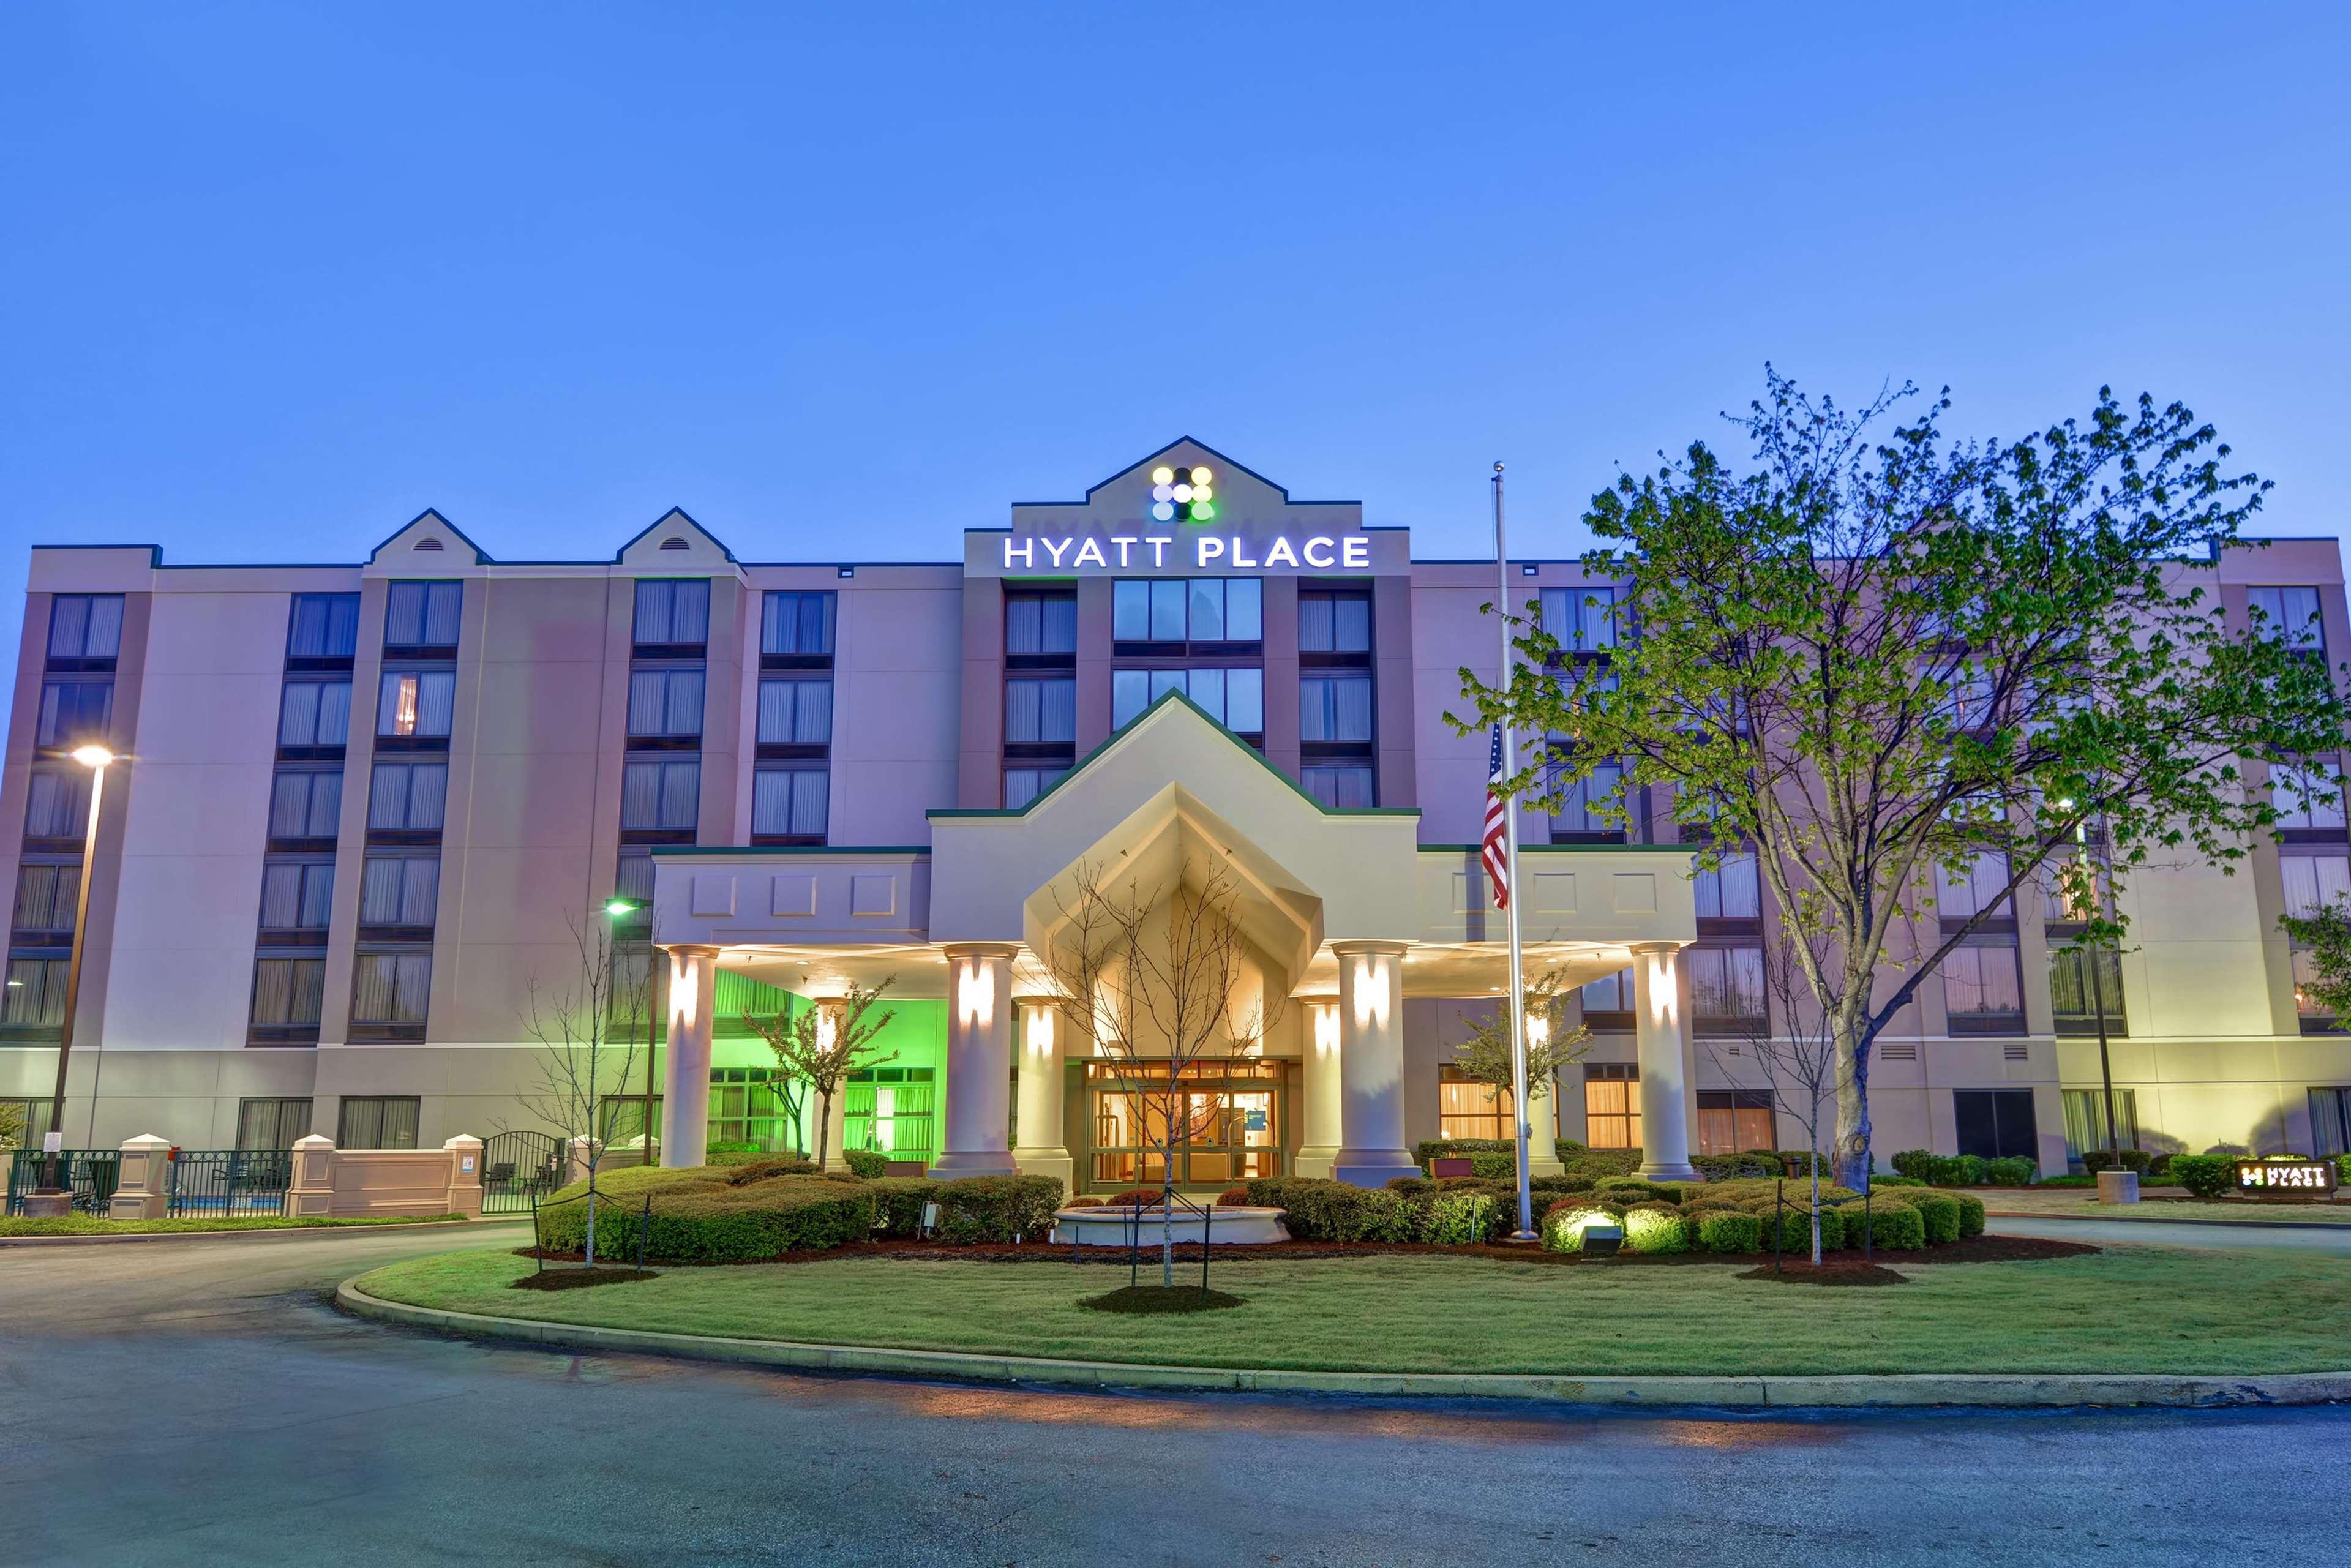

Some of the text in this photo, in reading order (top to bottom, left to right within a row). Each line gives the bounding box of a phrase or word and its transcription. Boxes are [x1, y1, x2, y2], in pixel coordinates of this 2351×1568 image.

[1004, 536, 1370, 568] HYATT PLACE
[2267, 1167, 2324, 1179] HYATT
[2267, 1177, 2325, 1187] PLACE
